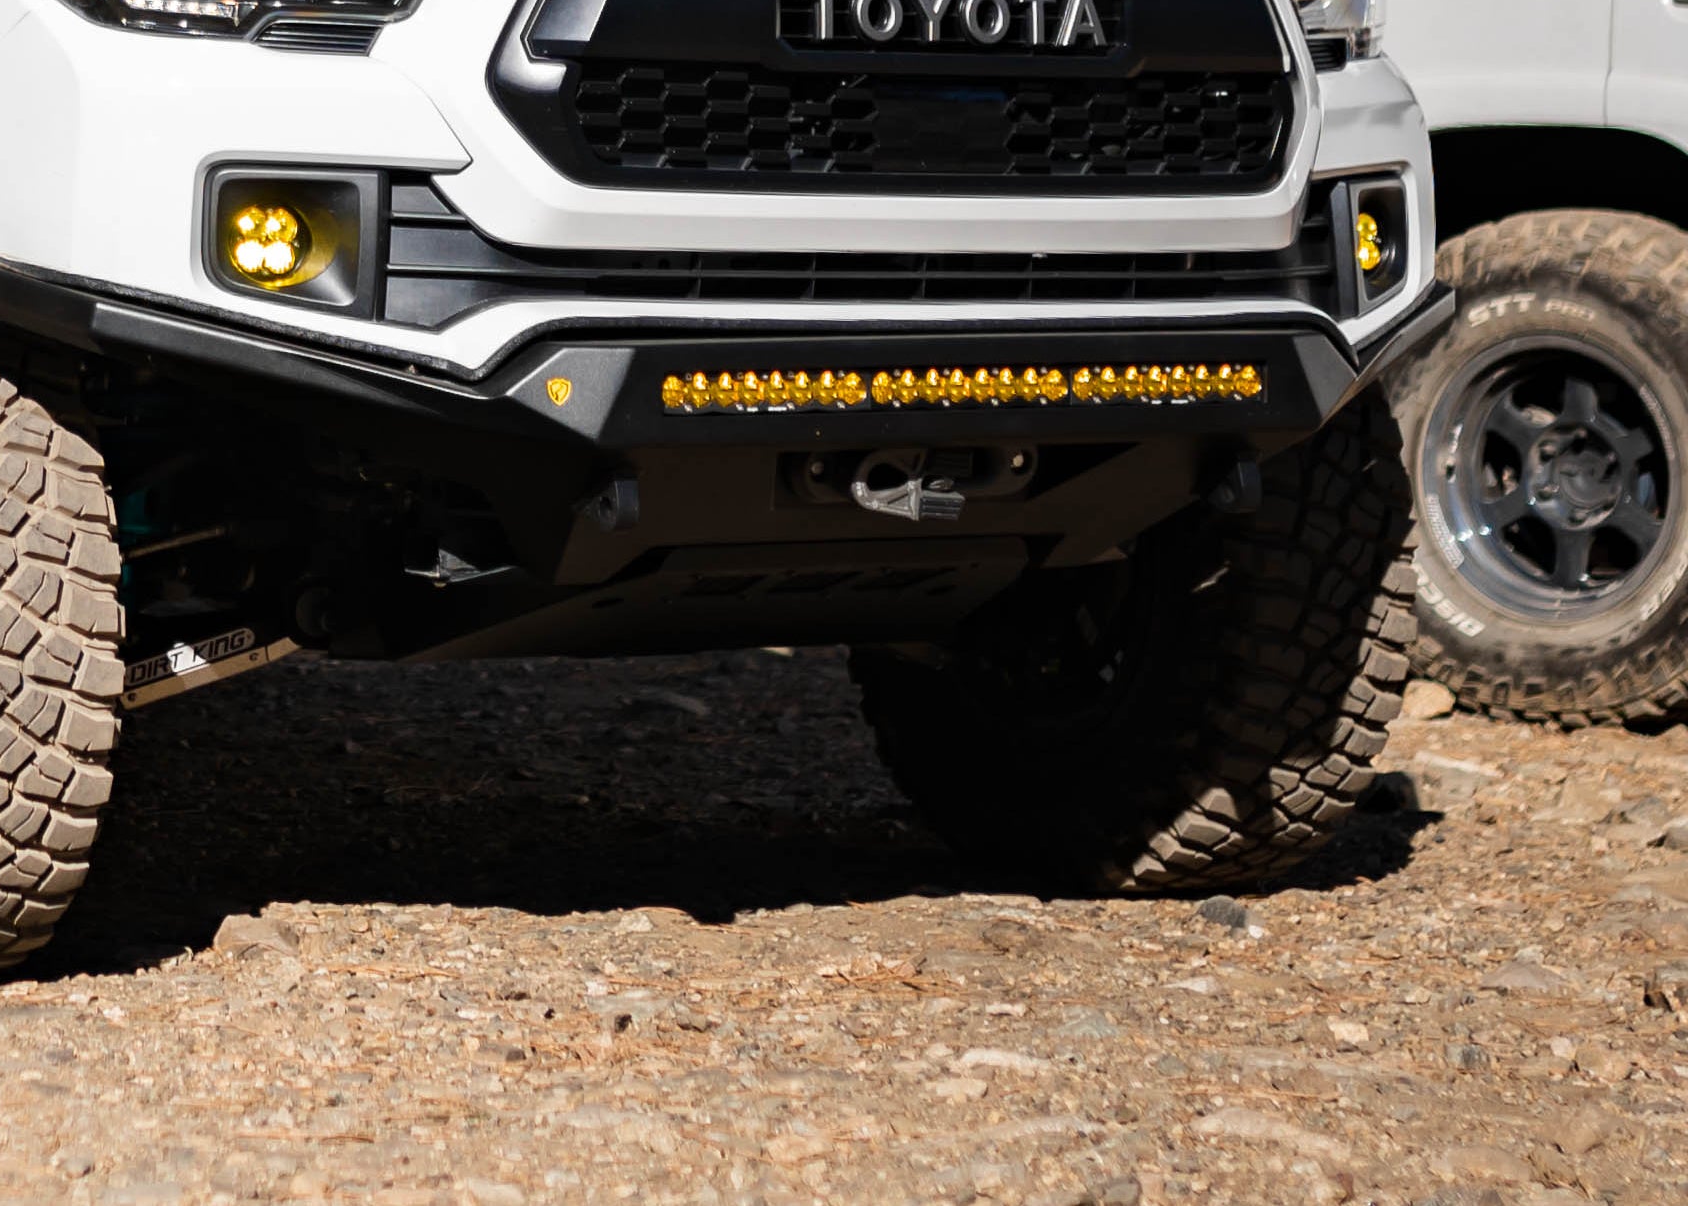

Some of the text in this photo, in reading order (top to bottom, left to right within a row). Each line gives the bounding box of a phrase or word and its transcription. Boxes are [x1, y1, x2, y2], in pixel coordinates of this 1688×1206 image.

[1468, 292, 1536, 327] STT
[131, 631, 246, 683] DIRT KING
